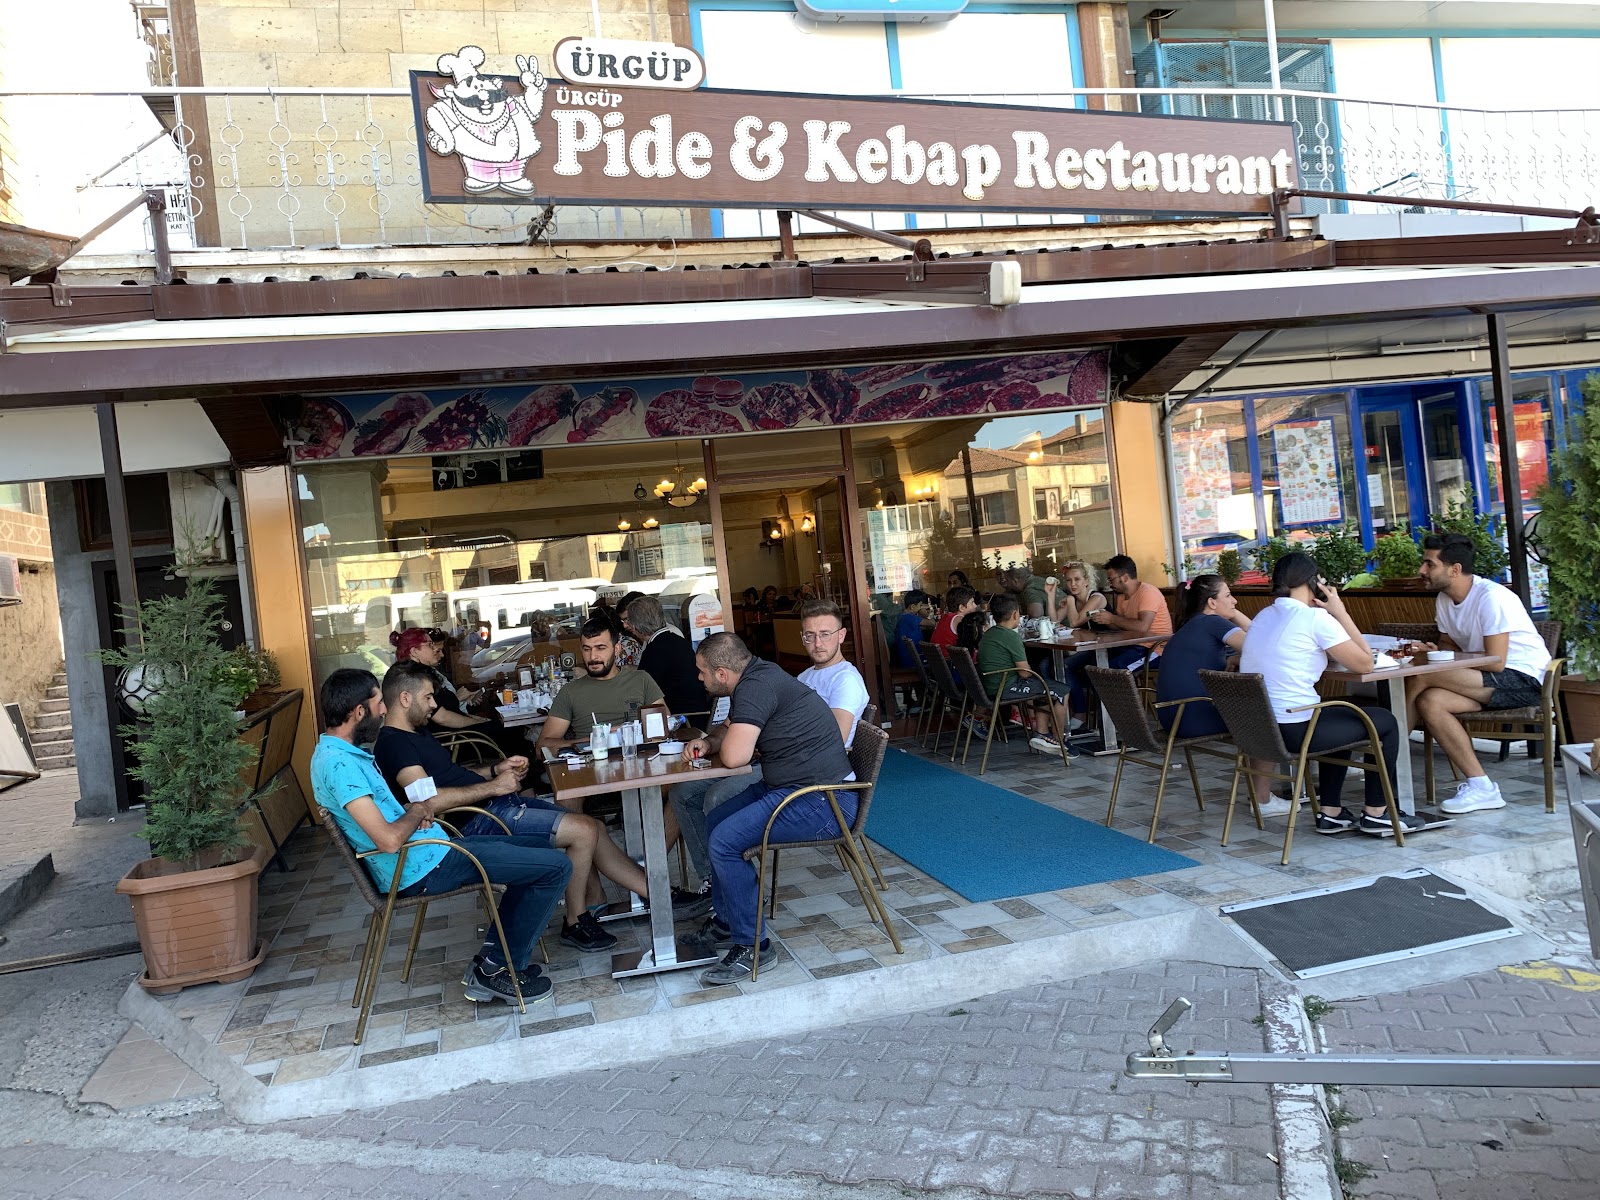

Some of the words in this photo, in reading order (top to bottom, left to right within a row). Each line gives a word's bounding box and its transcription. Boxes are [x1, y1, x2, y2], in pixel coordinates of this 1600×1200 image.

[570, 46, 692, 83] ÜRGÜP
[556, 87, 624, 108] ÜRGÜP
[551, 109, 713, 179] Pide
[729, 115, 789, 181] &
[803, 119, 1001, 200] Kebap
[1011, 130, 1293, 196] Restaurant
